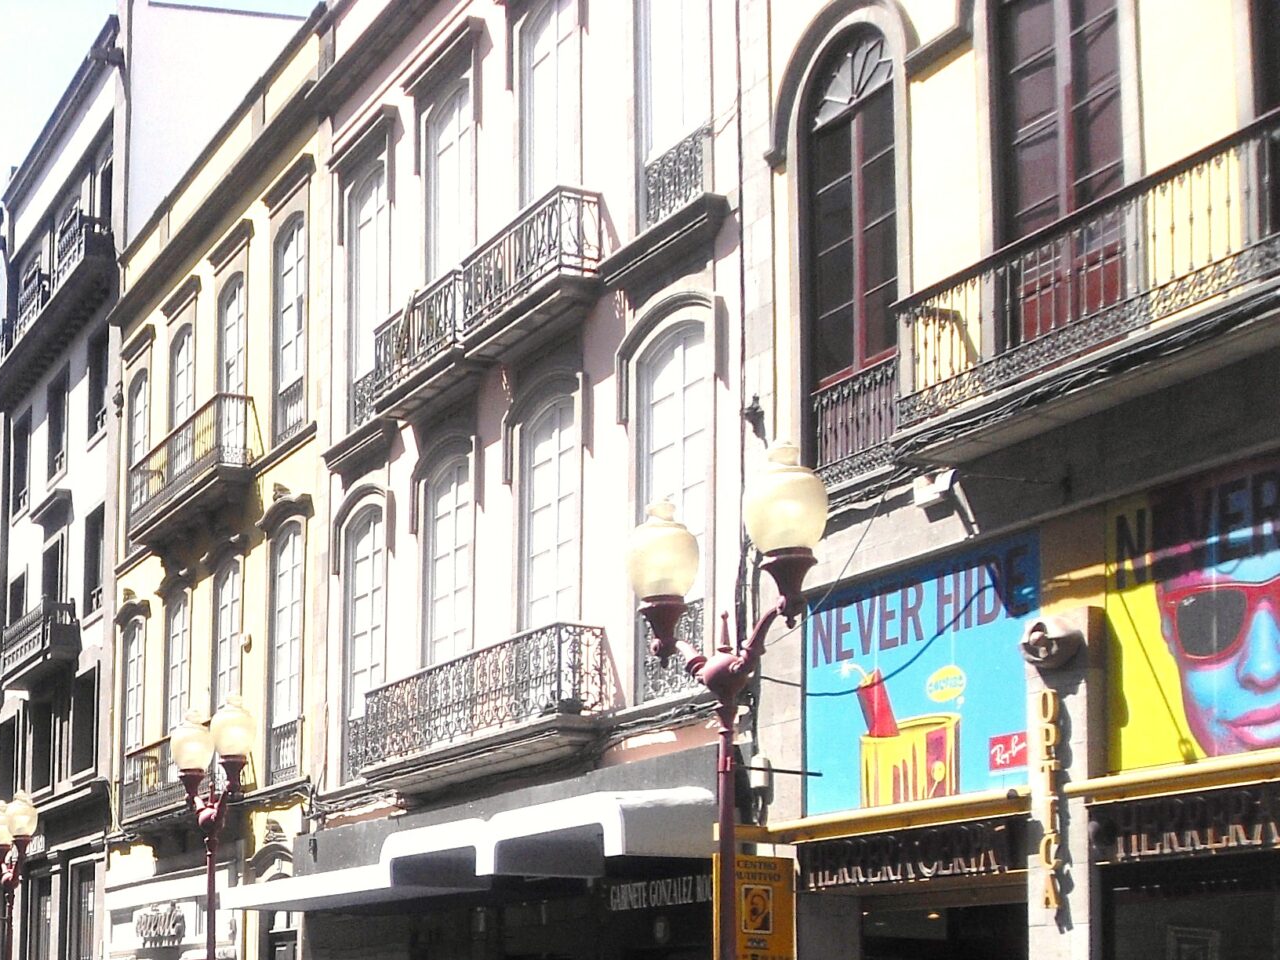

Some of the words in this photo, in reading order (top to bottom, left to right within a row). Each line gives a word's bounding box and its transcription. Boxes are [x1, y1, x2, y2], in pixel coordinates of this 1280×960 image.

[812, 577, 924, 669] NEVER
[935, 543, 1030, 637] HIDE
[649, 875, 694, 907] GONZALEZ
